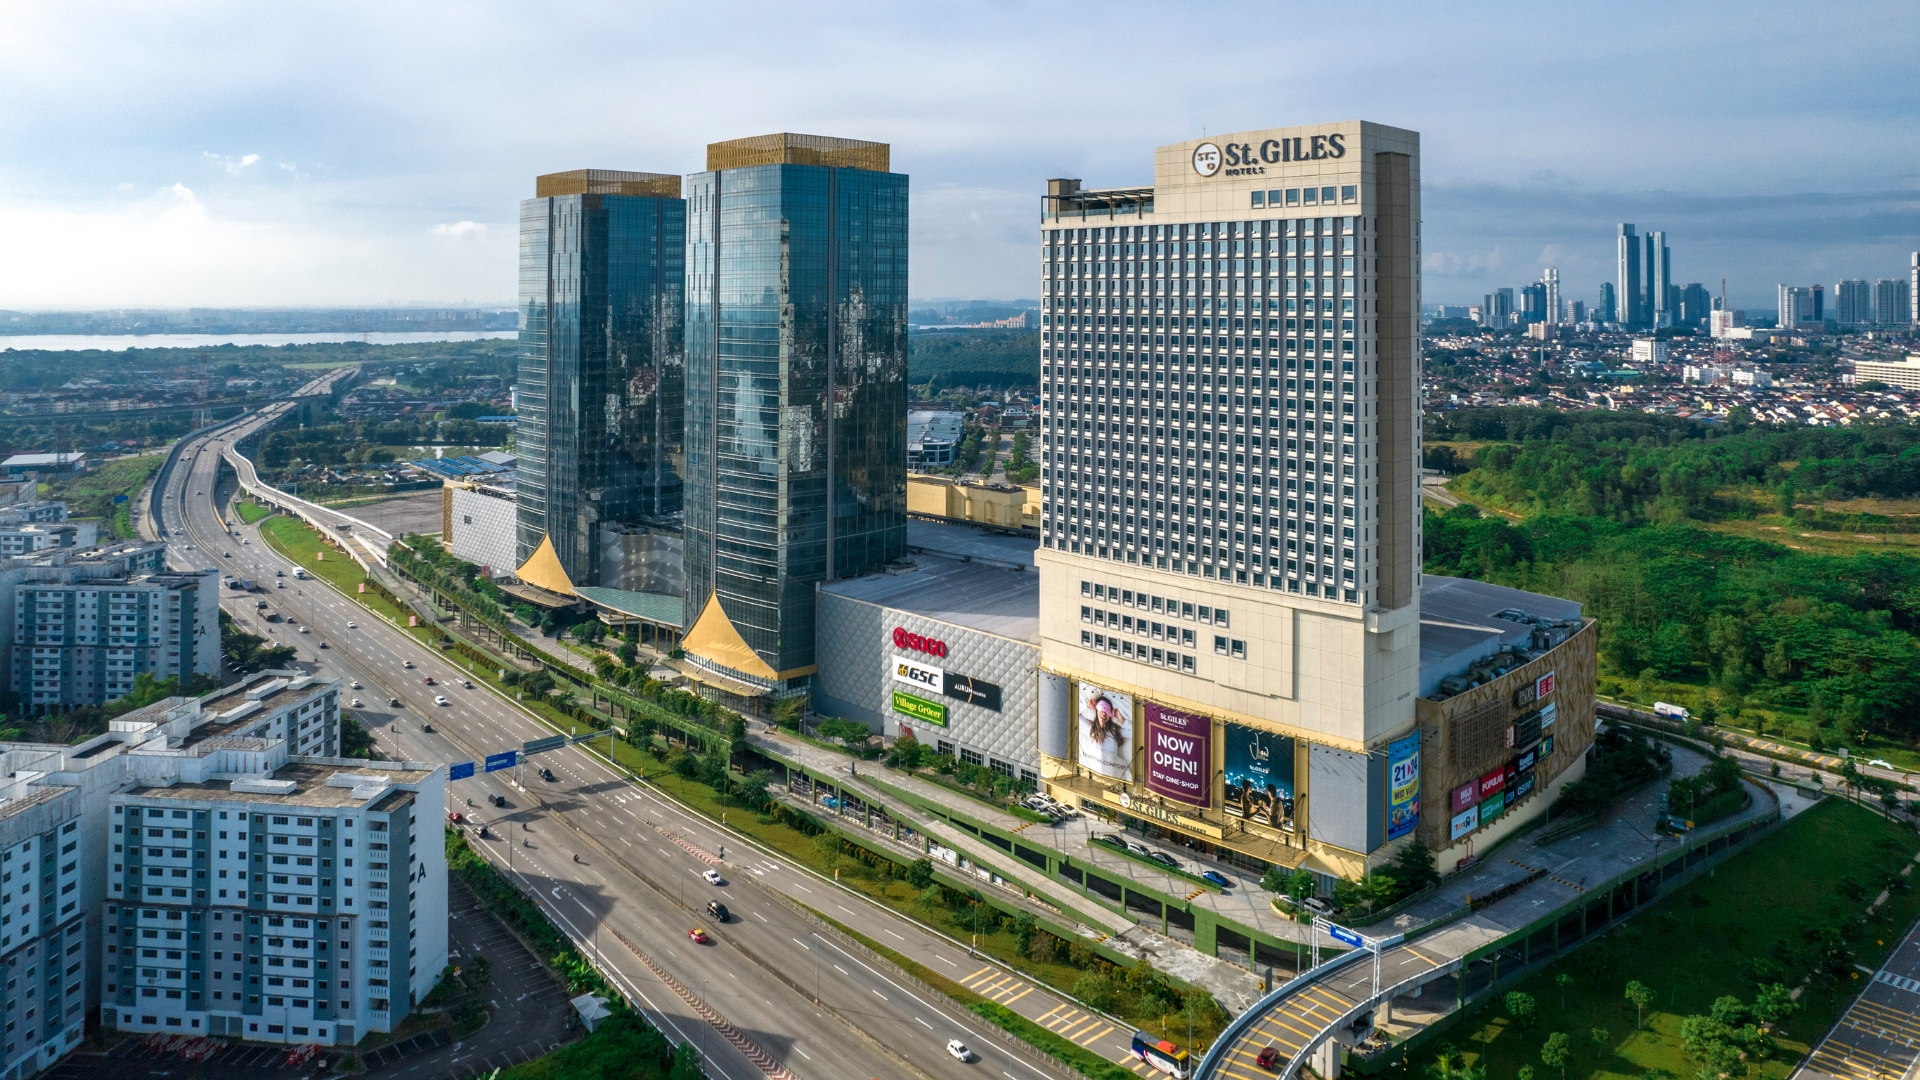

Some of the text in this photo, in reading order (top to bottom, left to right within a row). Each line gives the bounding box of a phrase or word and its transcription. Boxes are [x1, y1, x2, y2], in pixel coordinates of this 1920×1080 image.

[1260, 133, 1345, 163] GILES
[1225, 166, 1265, 176] HOTELS
[199, 625, 206, 637] A
[907, 632, 947, 658] SOGO
[909, 667, 939, 687] GSC
[954, 683, 973, 694] AURUM
[895, 696, 942, 718] Village Grocer
[1168, 715, 1187, 726] GILES
[1157, 732, 1194, 755] NOW
[1153, 751, 1198, 775] OPEN!
[1394, 764, 1406, 783] 21
[1411, 756, 1418, 776] 24
[1481, 774, 1504, 792] POPULAR
[1517, 780, 1531, 796] OSIM
[1394, 789, 1405, 801] MID
[1145, 805, 1179, 825] GILES
[417, 862, 427, 884] A
